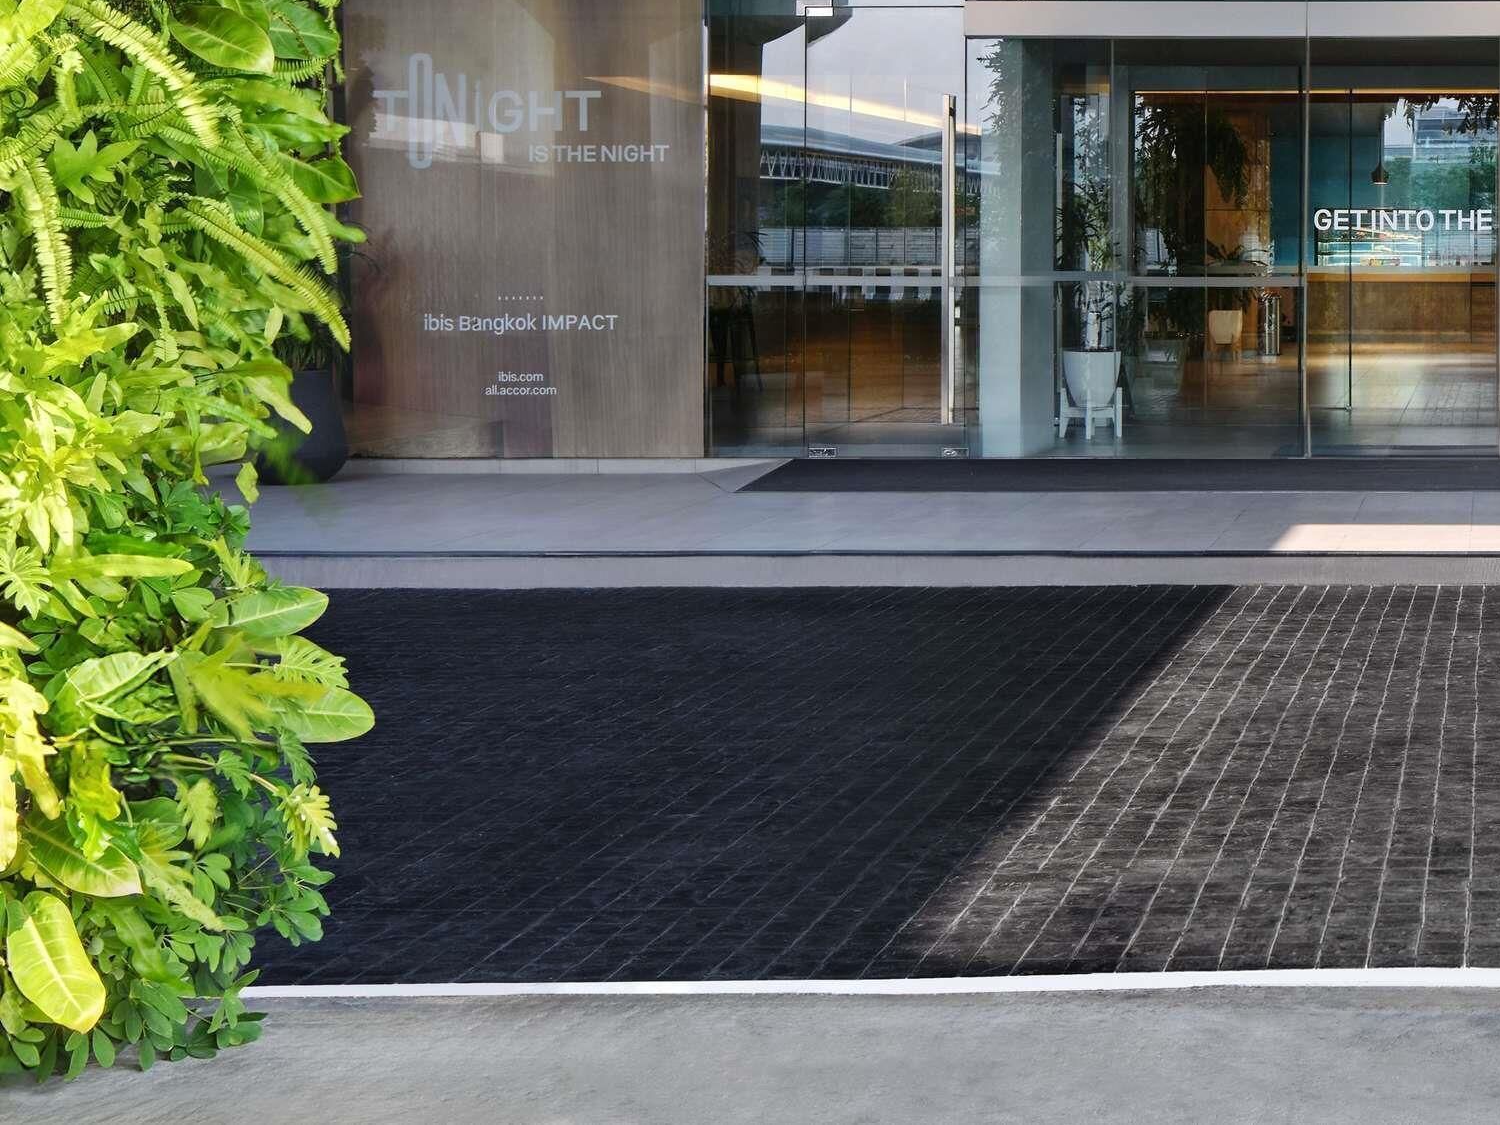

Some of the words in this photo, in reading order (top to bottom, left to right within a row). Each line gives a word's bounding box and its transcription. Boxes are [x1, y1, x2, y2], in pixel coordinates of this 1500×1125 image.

[373, 53, 602, 169] TONIGHT
[528, 144, 549, 163] IS
[551, 144, 597, 163] THE
[600, 144, 670, 163] NIGHT
[1313, 208, 1368, 231] GET
[1371, 208, 1435, 232] INTO
[1438, 209, 1493, 231] THE
[423, 313, 454, 331] ibis
[458, 313, 537, 335] Bangkok
[541, 315, 619, 331] IMPACT
[498, 372, 544, 382] ibis.com
[485, 385, 557, 396] all.accor.com
